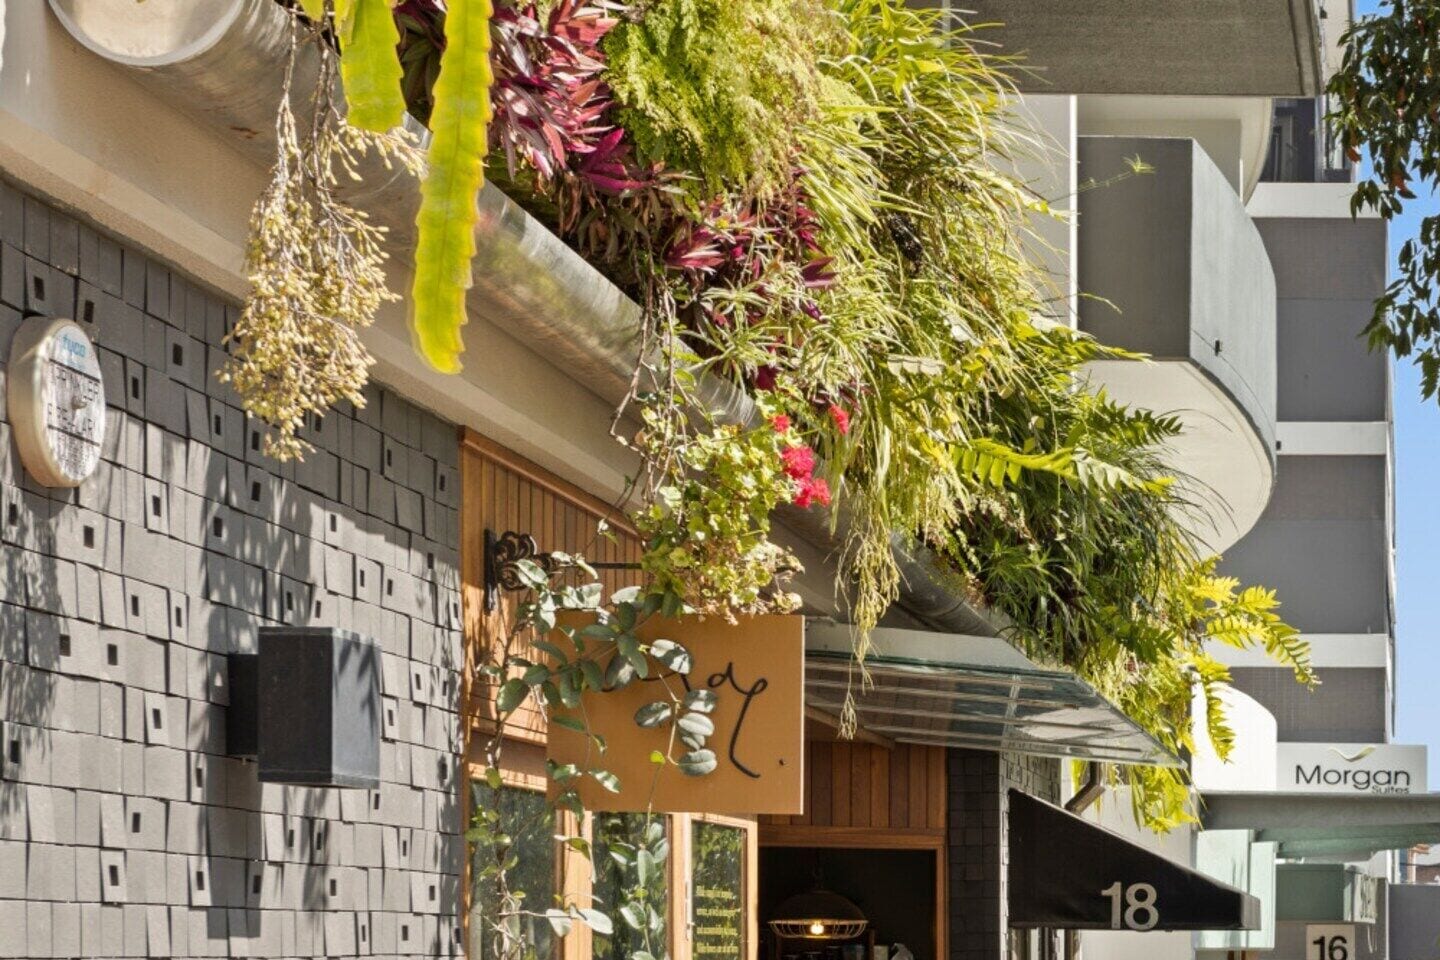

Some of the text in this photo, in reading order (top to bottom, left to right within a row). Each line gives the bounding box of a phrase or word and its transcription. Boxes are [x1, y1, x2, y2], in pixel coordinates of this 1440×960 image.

[1295, 764, 1411, 790] Morgan
[1371, 784, 1410, 795] Suites
[1101, 881, 1159, 931] 18
